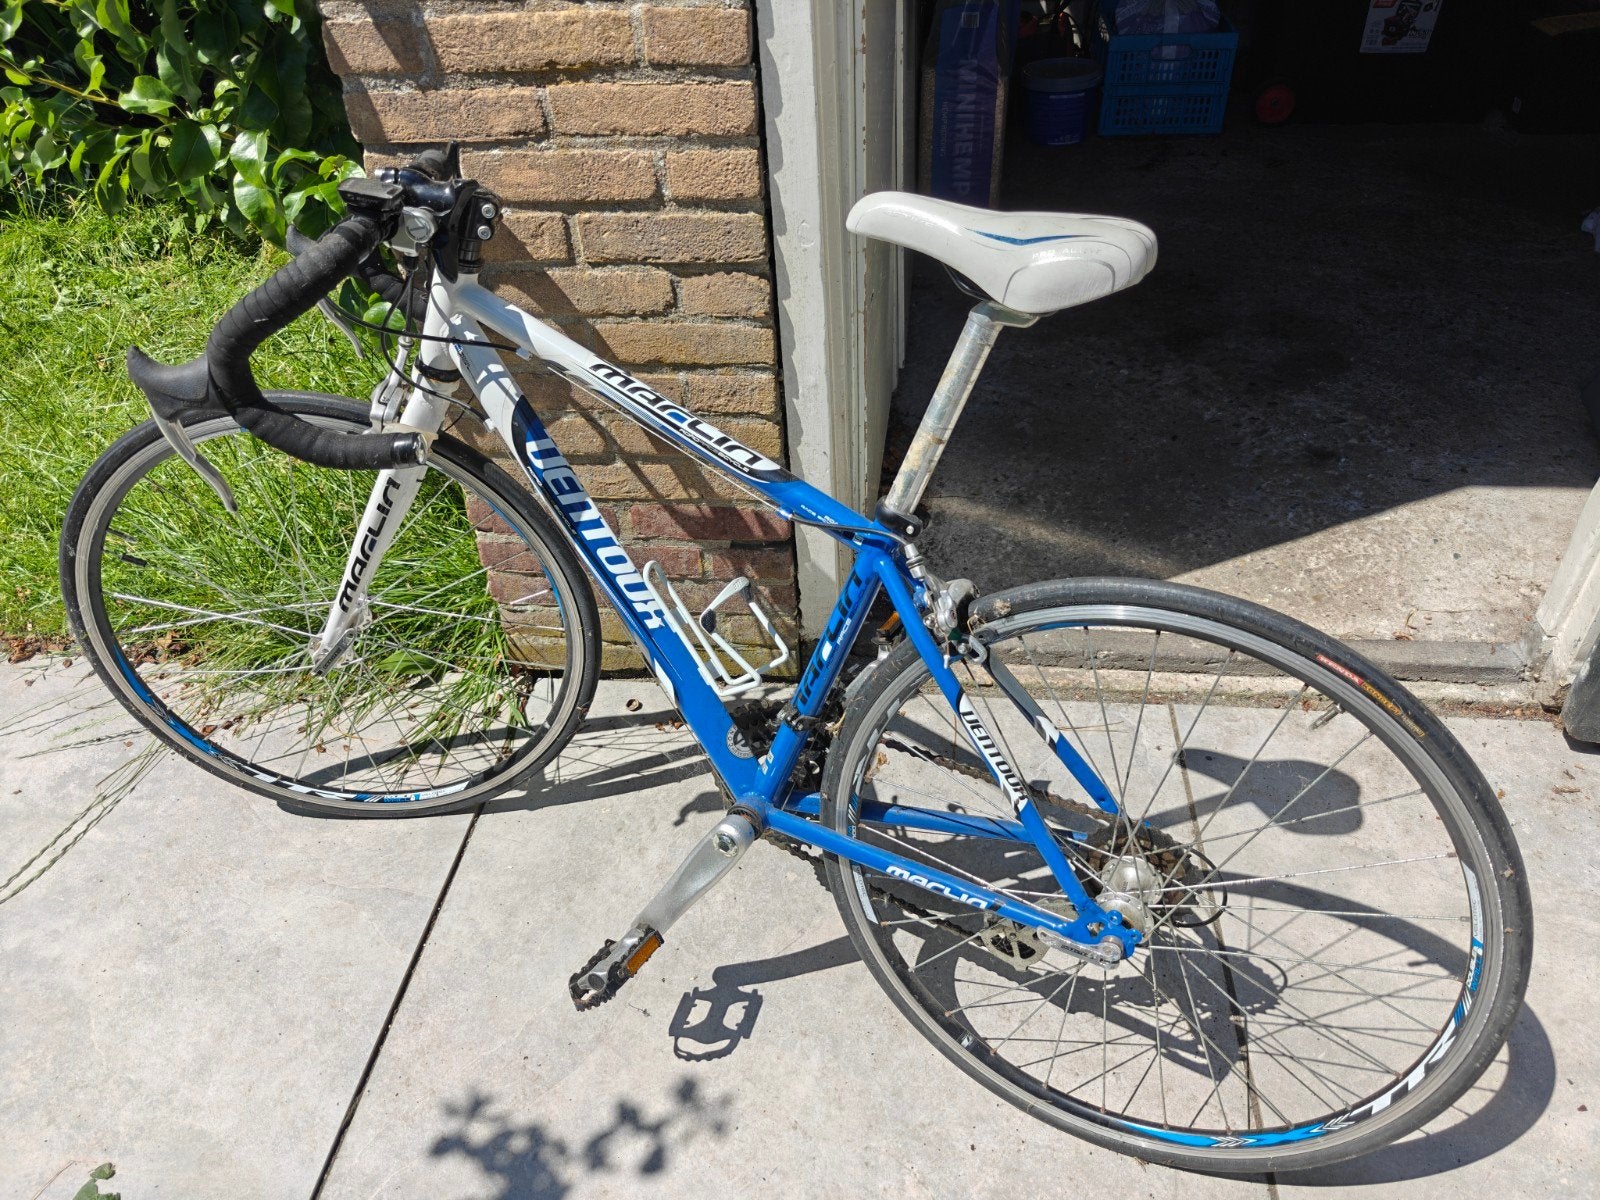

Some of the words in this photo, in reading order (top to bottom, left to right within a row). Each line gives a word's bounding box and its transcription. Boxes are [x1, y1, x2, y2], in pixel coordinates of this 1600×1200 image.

[952, 59, 977, 197] MINIHEMP
[525, 438, 666, 630] VENTOUR
[838, 617, 853, 645] RACE
[960, 710, 1028, 801] VENTOUR
